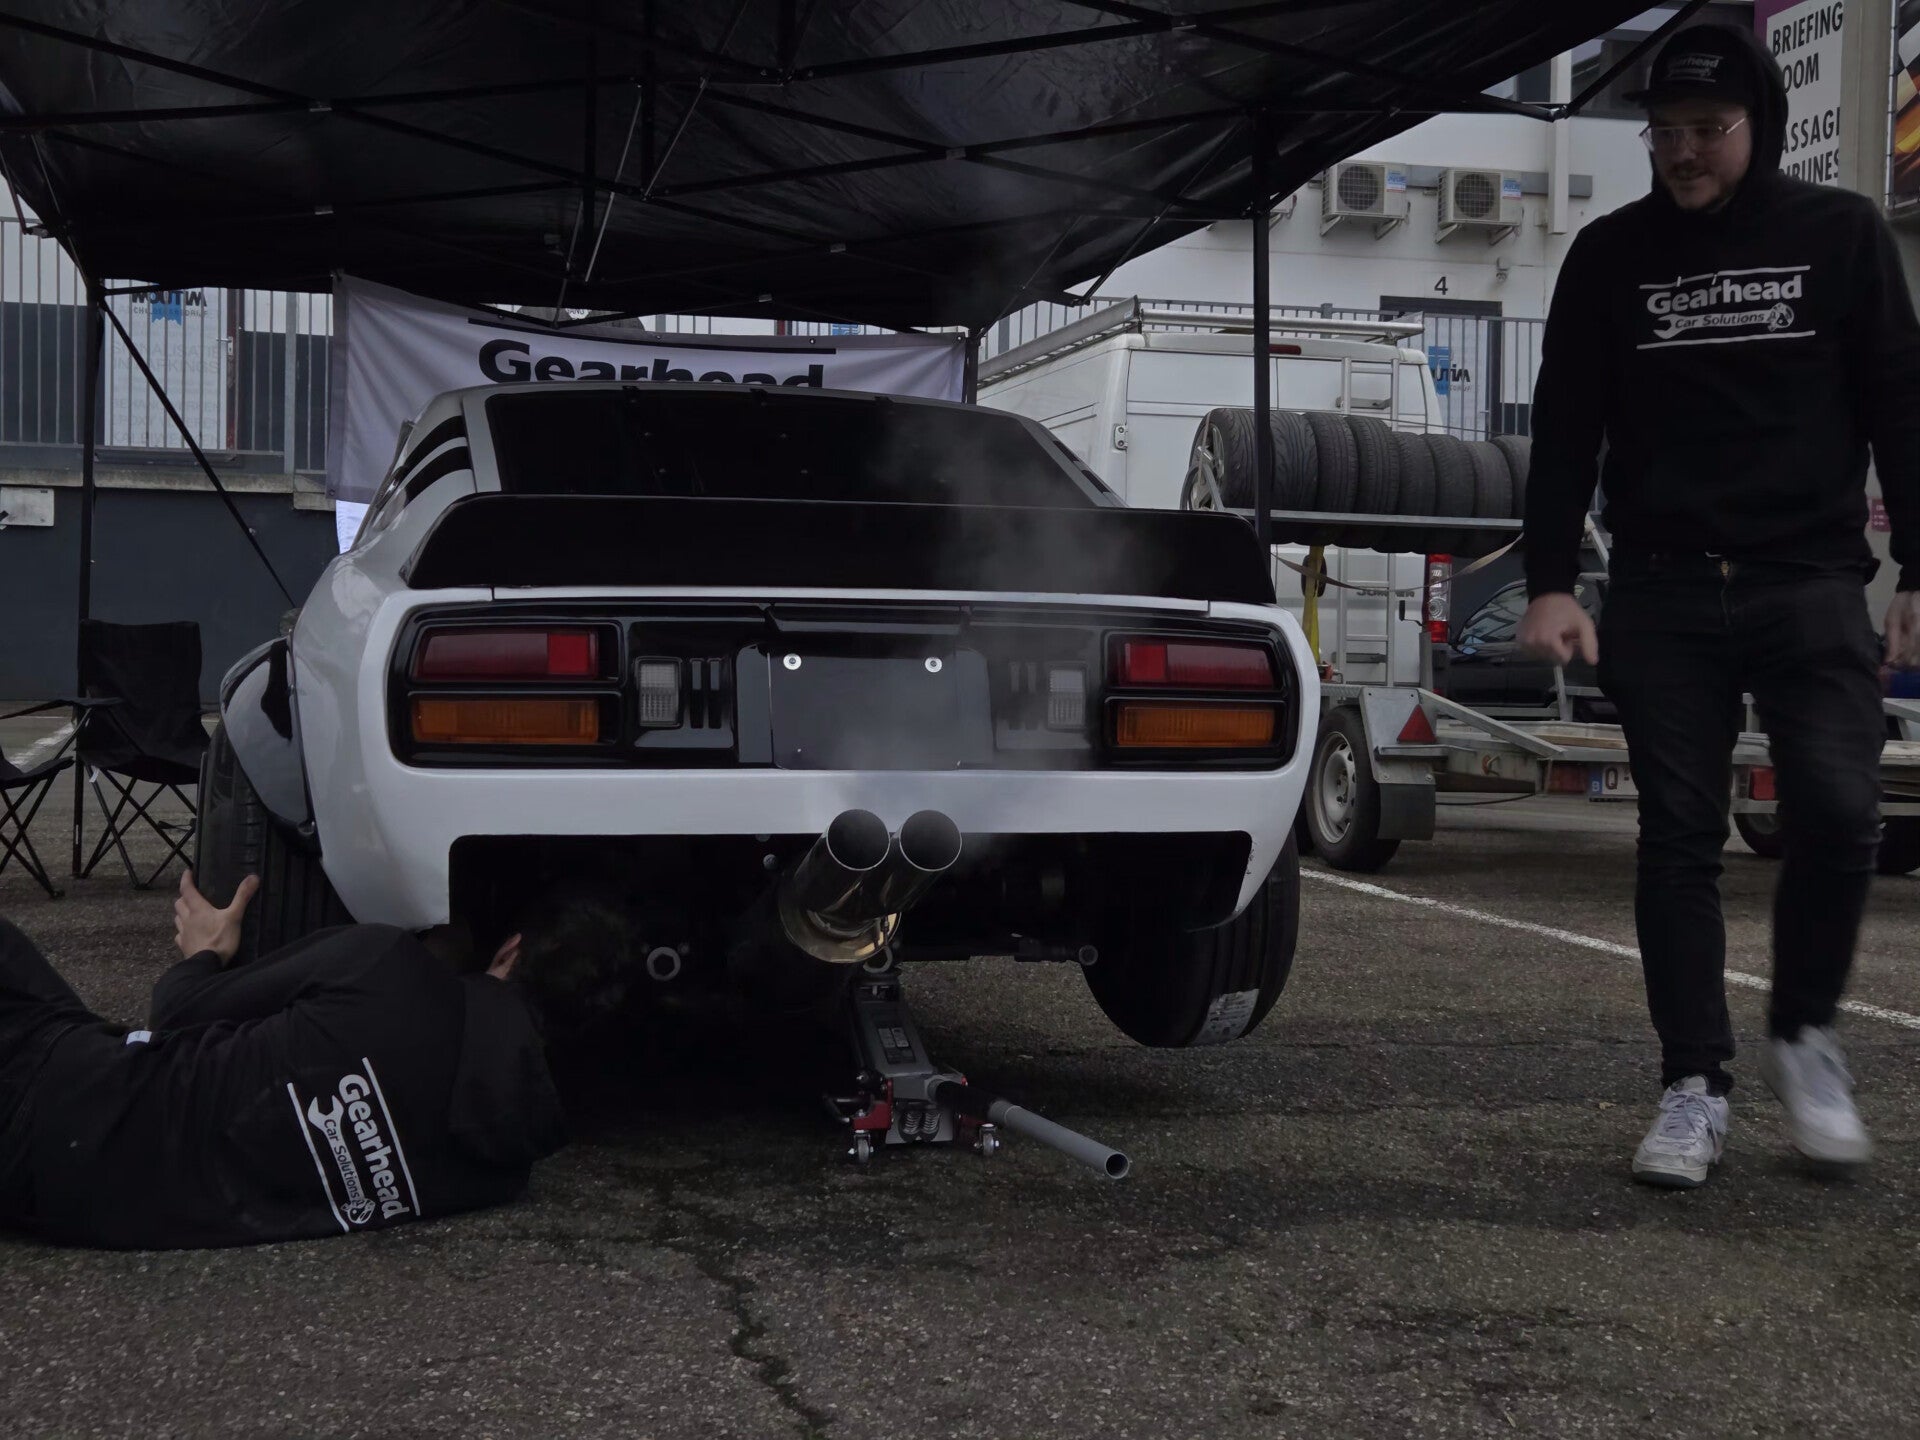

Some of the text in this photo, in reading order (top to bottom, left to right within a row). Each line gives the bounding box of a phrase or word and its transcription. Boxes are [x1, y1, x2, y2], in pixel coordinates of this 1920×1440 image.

[1773, 2, 1843, 57] BRIEFING
[1782, 52, 1819, 93] OOM
[1783, 107, 1840, 153] ASSAG
[1434, 276, 1448, 295] 4
[1647, 275, 1803, 314] Gearhead
[1675, 312, 1764, 329] Car Solutions
[323, 1119, 360, 1199] Car Solutions
[338, 1074, 410, 1219] Gearhead
